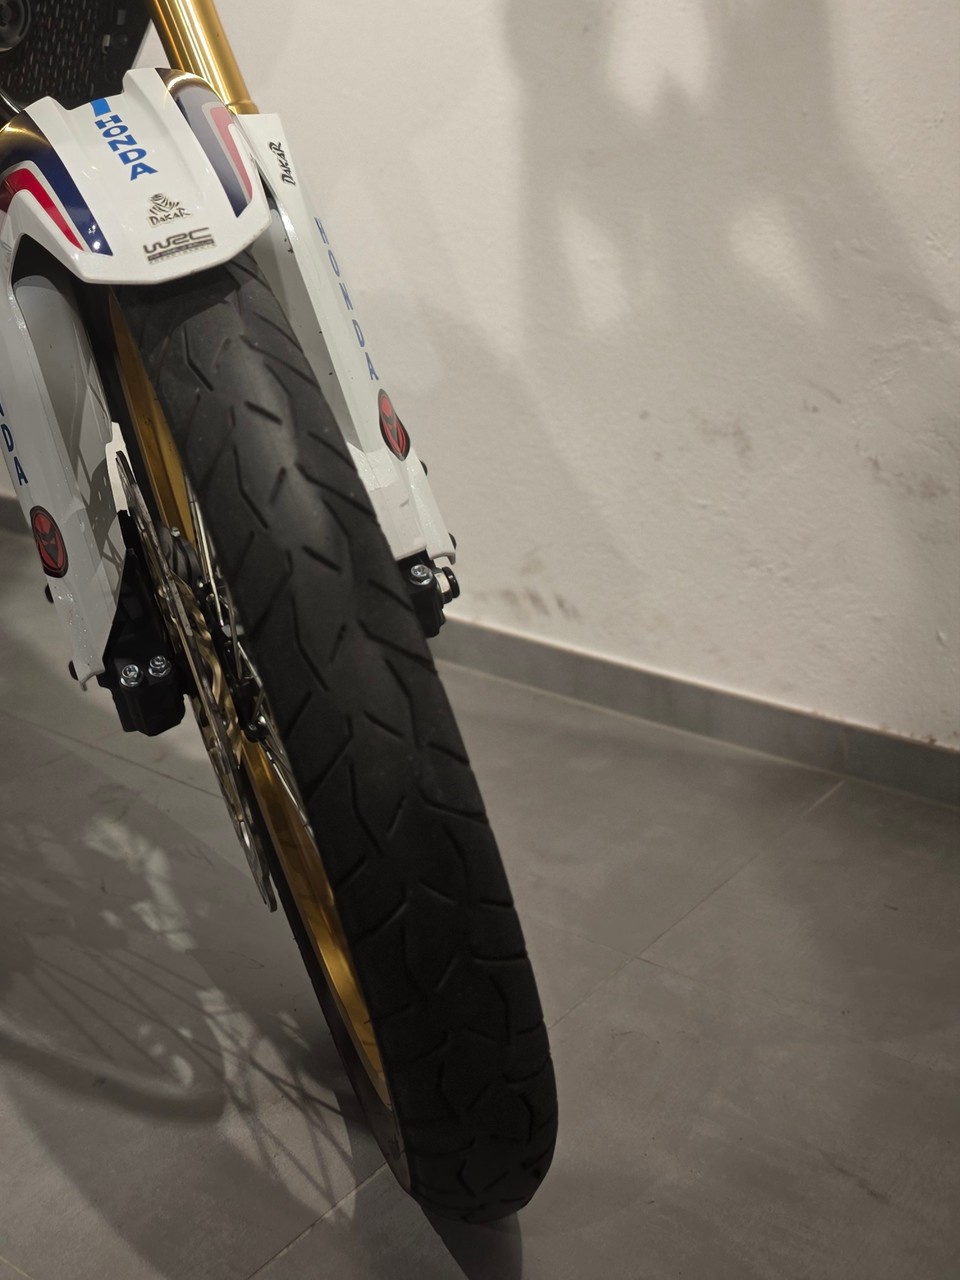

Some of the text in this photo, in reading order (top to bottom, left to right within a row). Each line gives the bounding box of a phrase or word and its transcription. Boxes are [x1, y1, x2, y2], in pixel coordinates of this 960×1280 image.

[94, 114, 158, 181] HONDA
[270, 141, 297, 186] DAKAR
[149, 207, 191, 225] DAKAR
[143, 227, 212, 254] WRC
[314, 216, 380, 380] HONDA
